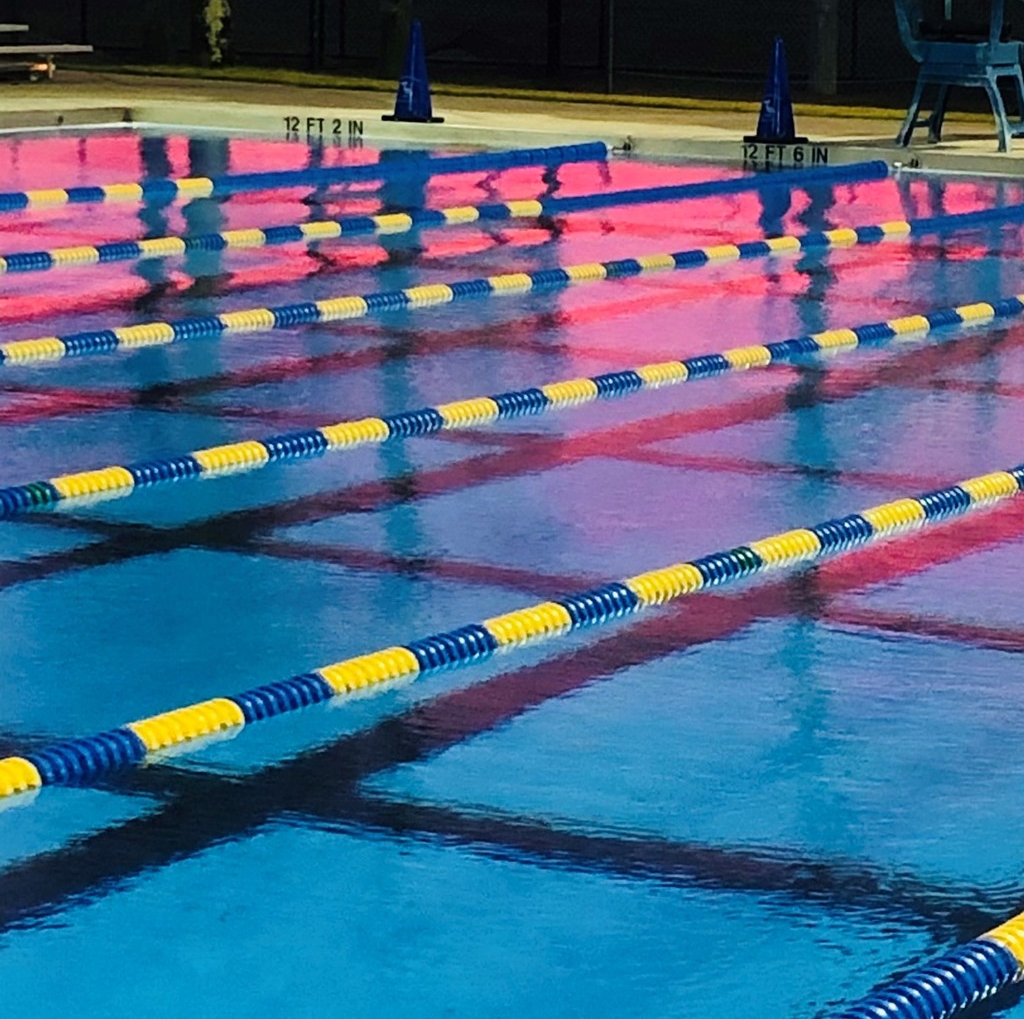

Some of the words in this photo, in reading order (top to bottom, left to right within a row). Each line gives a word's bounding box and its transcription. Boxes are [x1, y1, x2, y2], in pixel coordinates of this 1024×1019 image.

[284, 116, 300, 132] 12
[307, 117, 325, 133] FT
[332, 118, 342, 134] 2
[348, 120, 363, 135] IN
[742, 143, 758, 159] 12
[765, 145, 786, 161] FT
[793, 146, 804, 162] 6
[812, 147, 828, 163] IN
